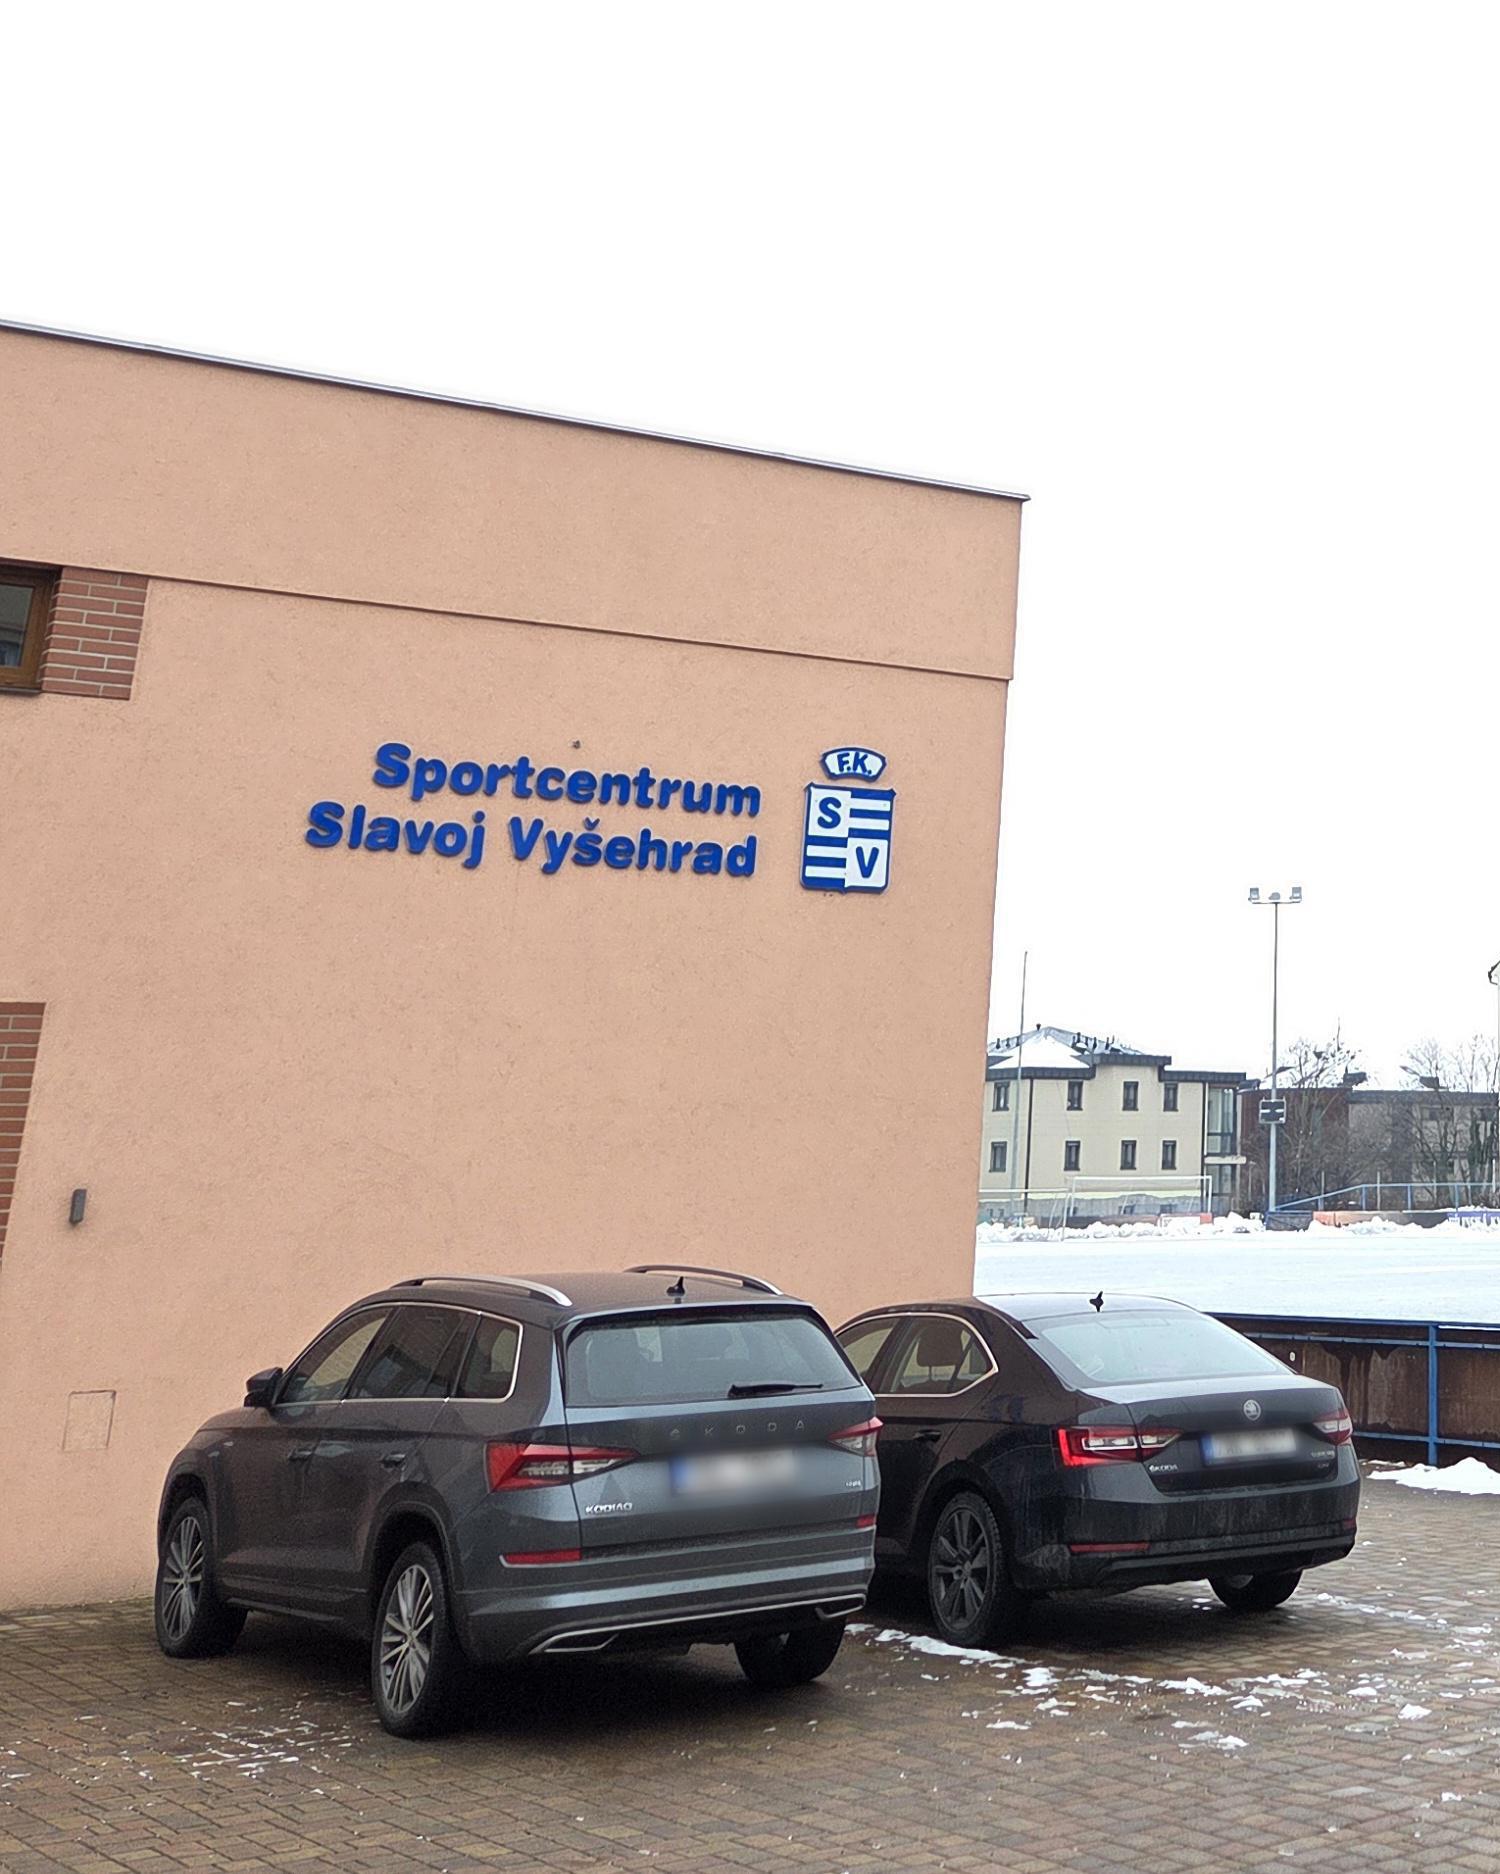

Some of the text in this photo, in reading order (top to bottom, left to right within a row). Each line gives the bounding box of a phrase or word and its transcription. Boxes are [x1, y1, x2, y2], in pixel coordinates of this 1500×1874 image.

[373, 742, 762, 817] Sportcentrum
[837, 751, 873, 775] F.K.
[816, 796, 842, 830] S
[306, 801, 759, 876] Slavoj Vyšehrad
[855, 846, 880, 880] V
